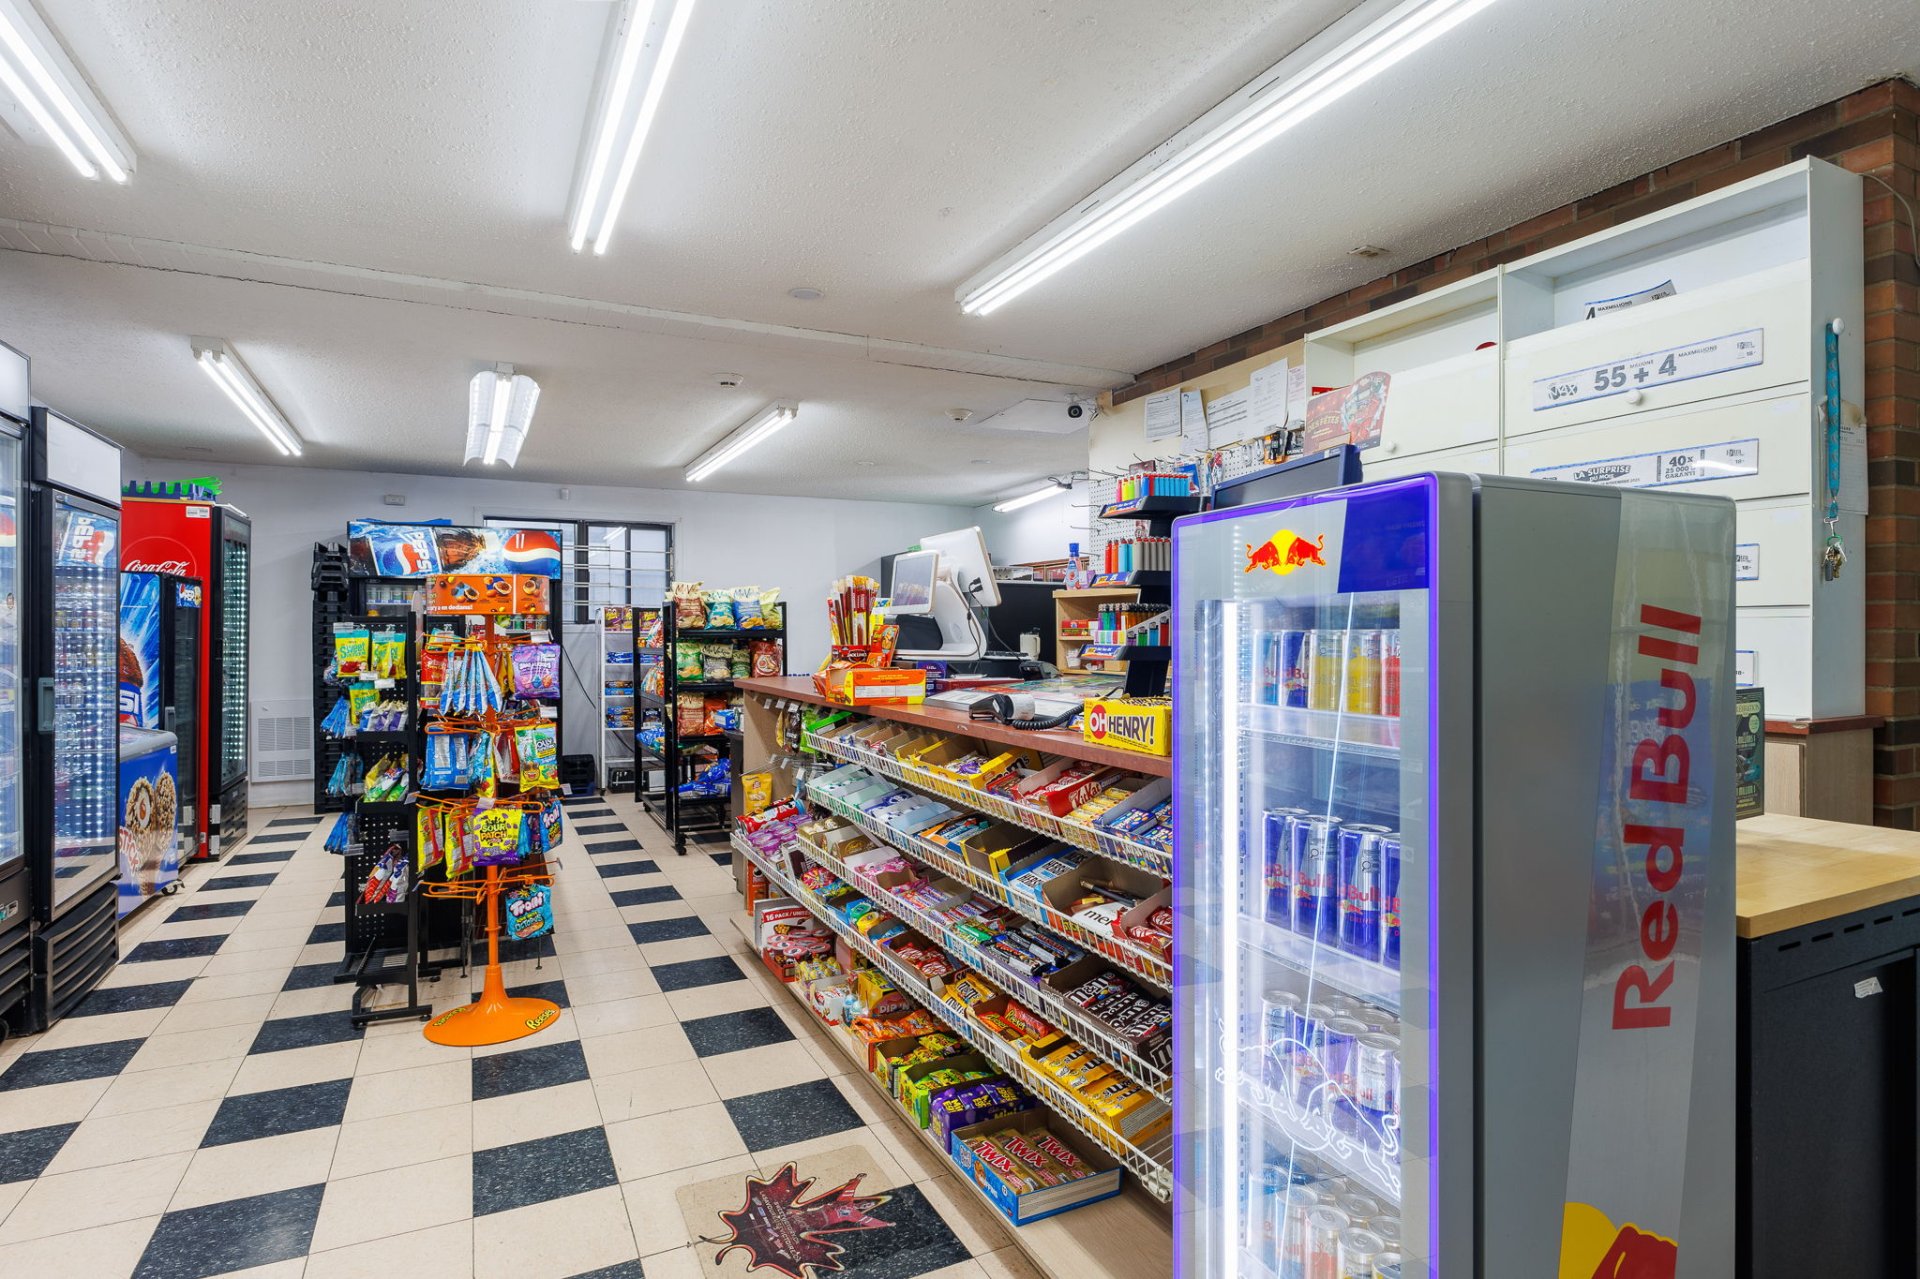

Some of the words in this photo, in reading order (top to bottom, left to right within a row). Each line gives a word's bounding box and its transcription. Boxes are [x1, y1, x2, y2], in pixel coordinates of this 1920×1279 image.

[1594, 364, 1627, 391] 55
[1658, 353, 1677, 376] 4
[1678, 345, 1718, 358] MAXMILLIONS
[1587, 465, 1632, 477] SURPRISE
[1629, 603, 1702, 805] Bull
[1089, 711, 1107, 732] OH
[1108, 715, 1155, 746] HENRY!
[480, 831, 508, 841] PATCH
[482, 822, 508, 833] SOUR
[1611, 824, 1685, 1032] Red
[880, 1004, 898, 1014] DIP
[973, 1140, 1016, 1172] TWIX
[1004, 1135, 1049, 1168] TWIX
